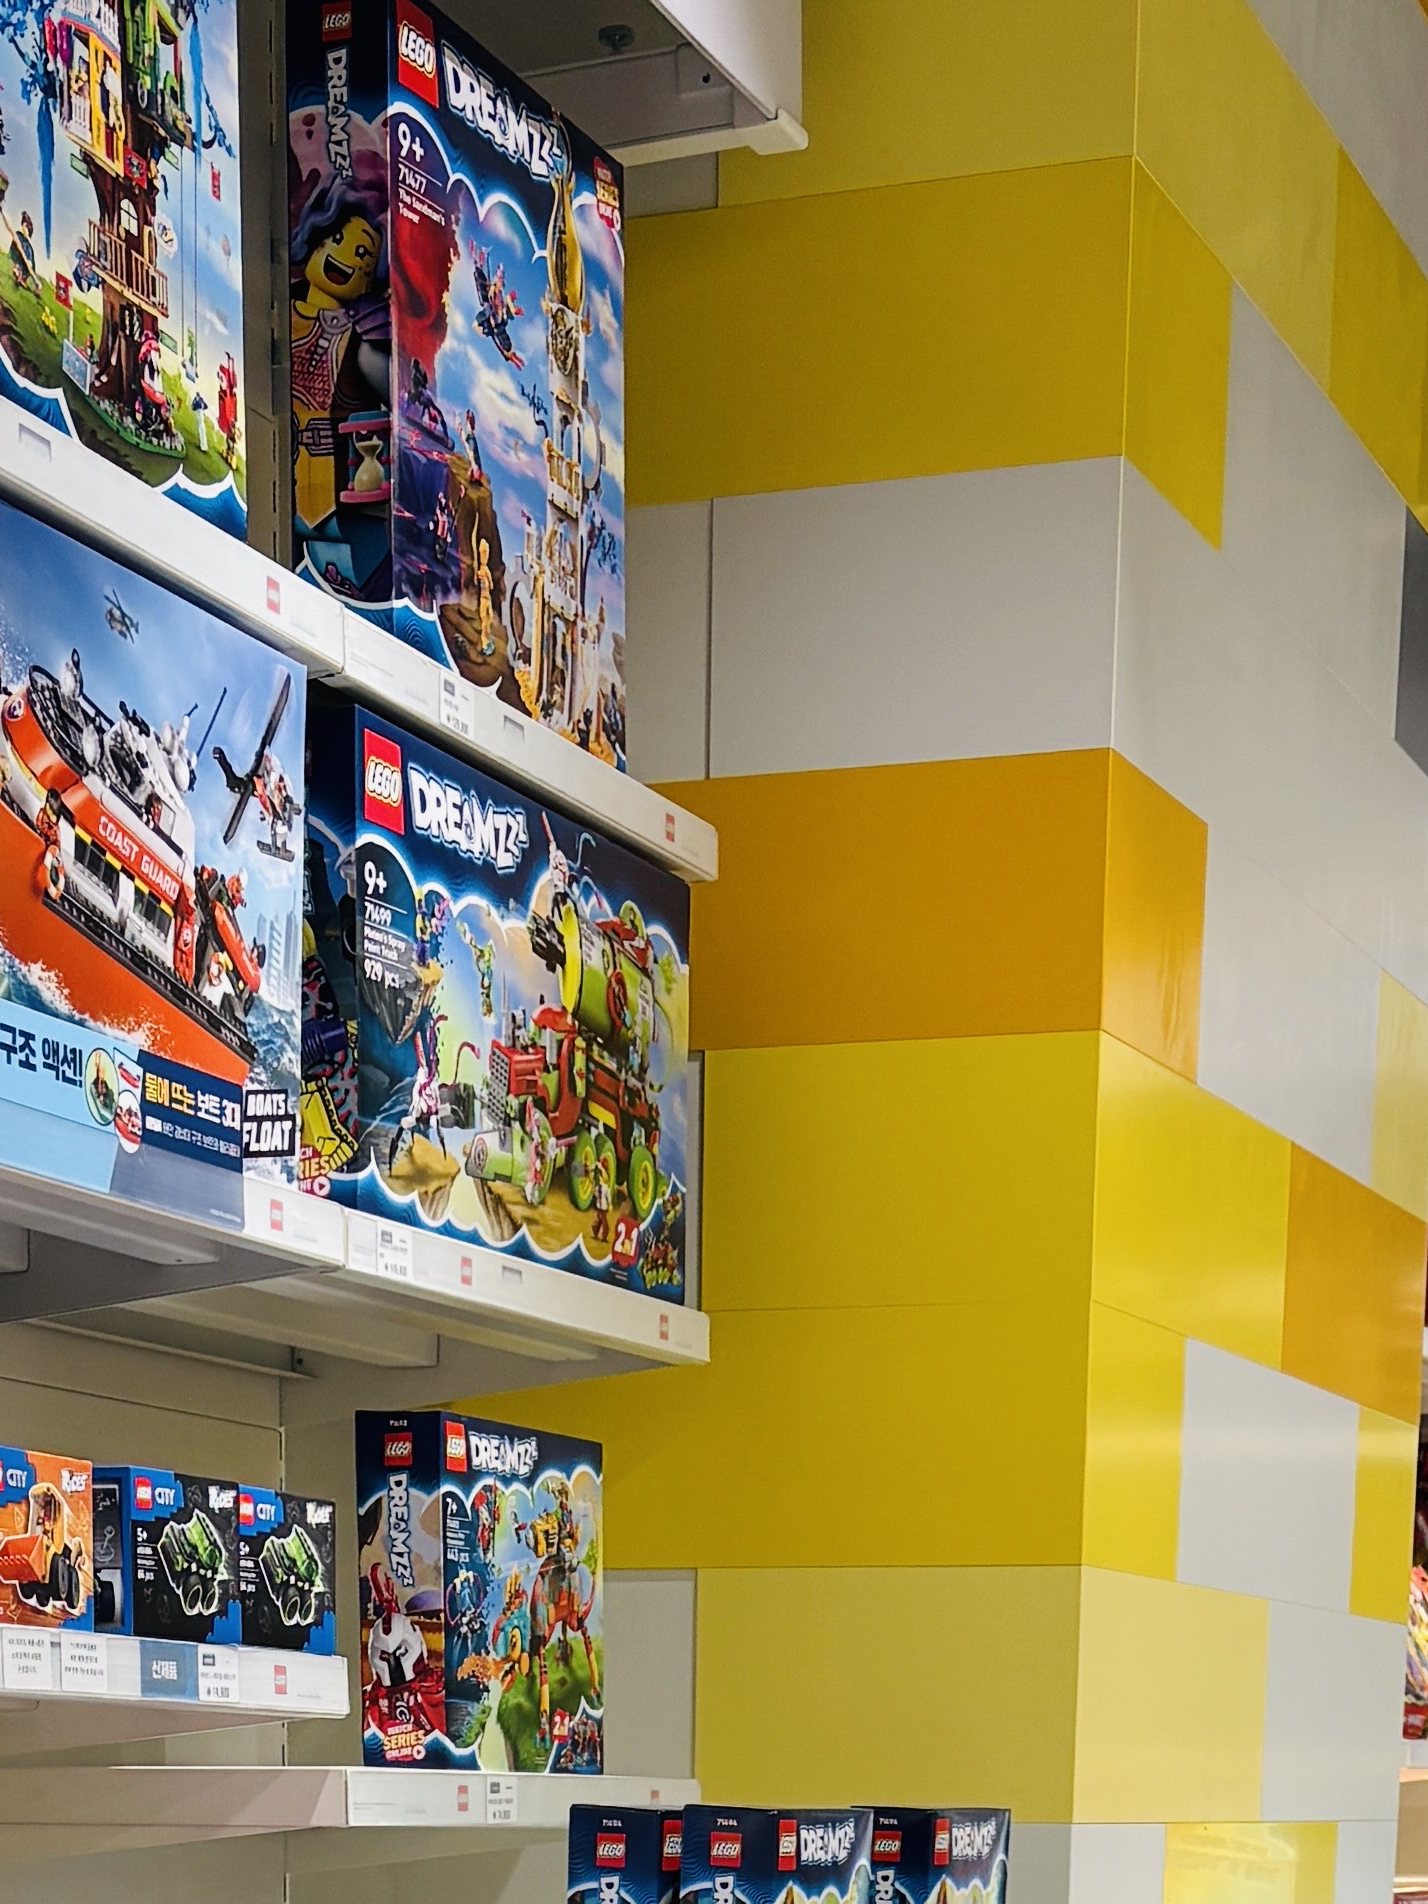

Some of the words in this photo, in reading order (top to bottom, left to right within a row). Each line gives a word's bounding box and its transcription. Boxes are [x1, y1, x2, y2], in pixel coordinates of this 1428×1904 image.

[324, 13, 350, 29] LEGO
[399, 21, 436, 77] LEGO
[397, 122, 425, 163] 9+
[398, 163, 427, 194] 71477
[369, 757, 401, 807] LEGO
[99, 816, 139, 862] COAST
[141, 854, 179, 900] GUARD
[364, 860, 387, 896] 9+
[364, 902, 392, 926] 71499
[364, 960, 382, 984] 929
[384, 967, 400, 989] pcs
[0, 1023, 37, 1072] 구조
[42, 1037, 83, 1088] 액션!
[145, 1072, 169, 1107] 물에
[171, 1082, 195, 1116] 뜨는
[197, 1090, 221, 1124] 보트
[222, 1100, 241, 1131] 3대
[246, 1093, 286, 1116] BOATS
[244, 1120, 293, 1152] FLOAT
[151, 1660, 177, 1680] 신제품
[384, 1731, 425, 1750] SERIES
[711, 1842, 740, 1859] LEGO
